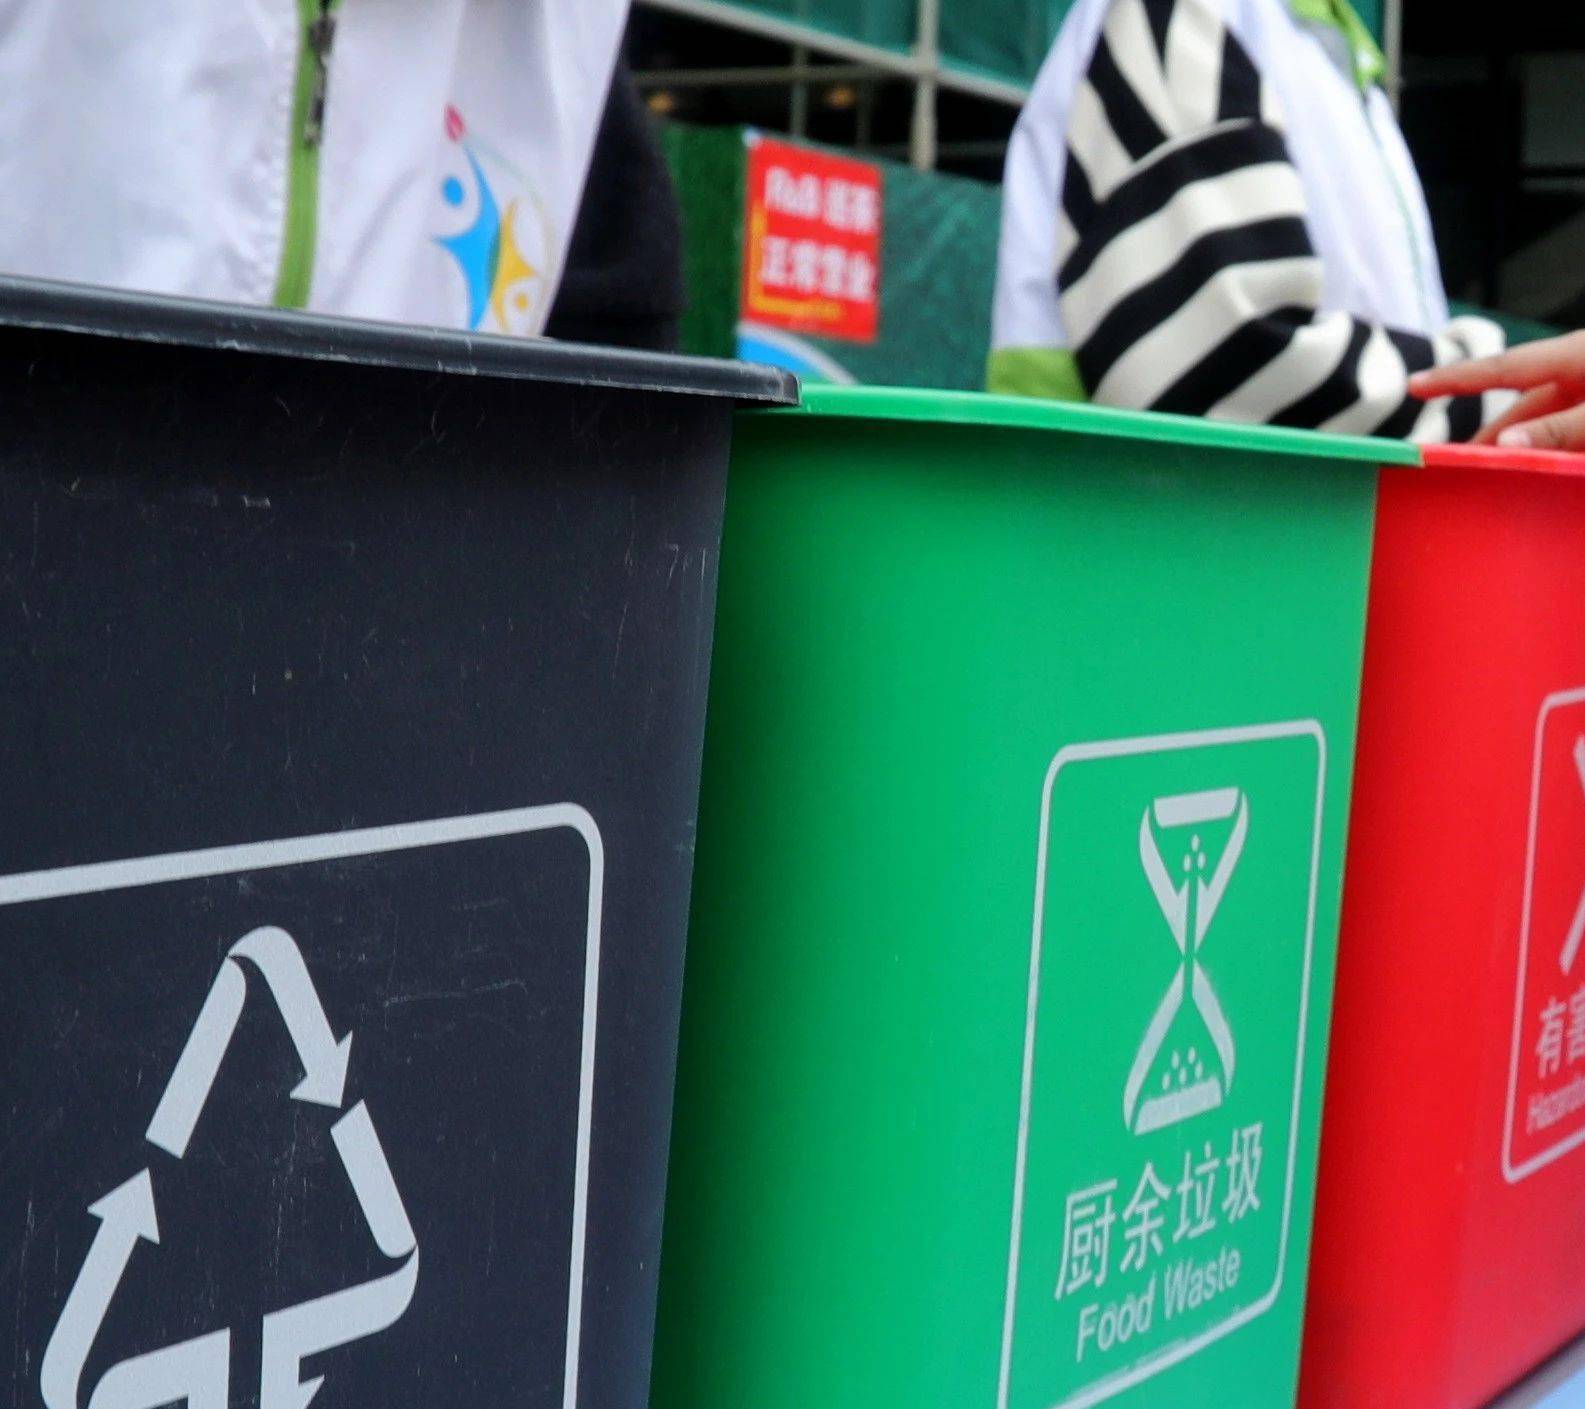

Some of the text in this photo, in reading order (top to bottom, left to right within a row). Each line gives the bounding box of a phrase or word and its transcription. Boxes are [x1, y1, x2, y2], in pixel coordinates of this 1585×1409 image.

[1054, 1121, 1263, 1301] 厨余垃圾
[1075, 1246, 1241, 1363] Food Waste
